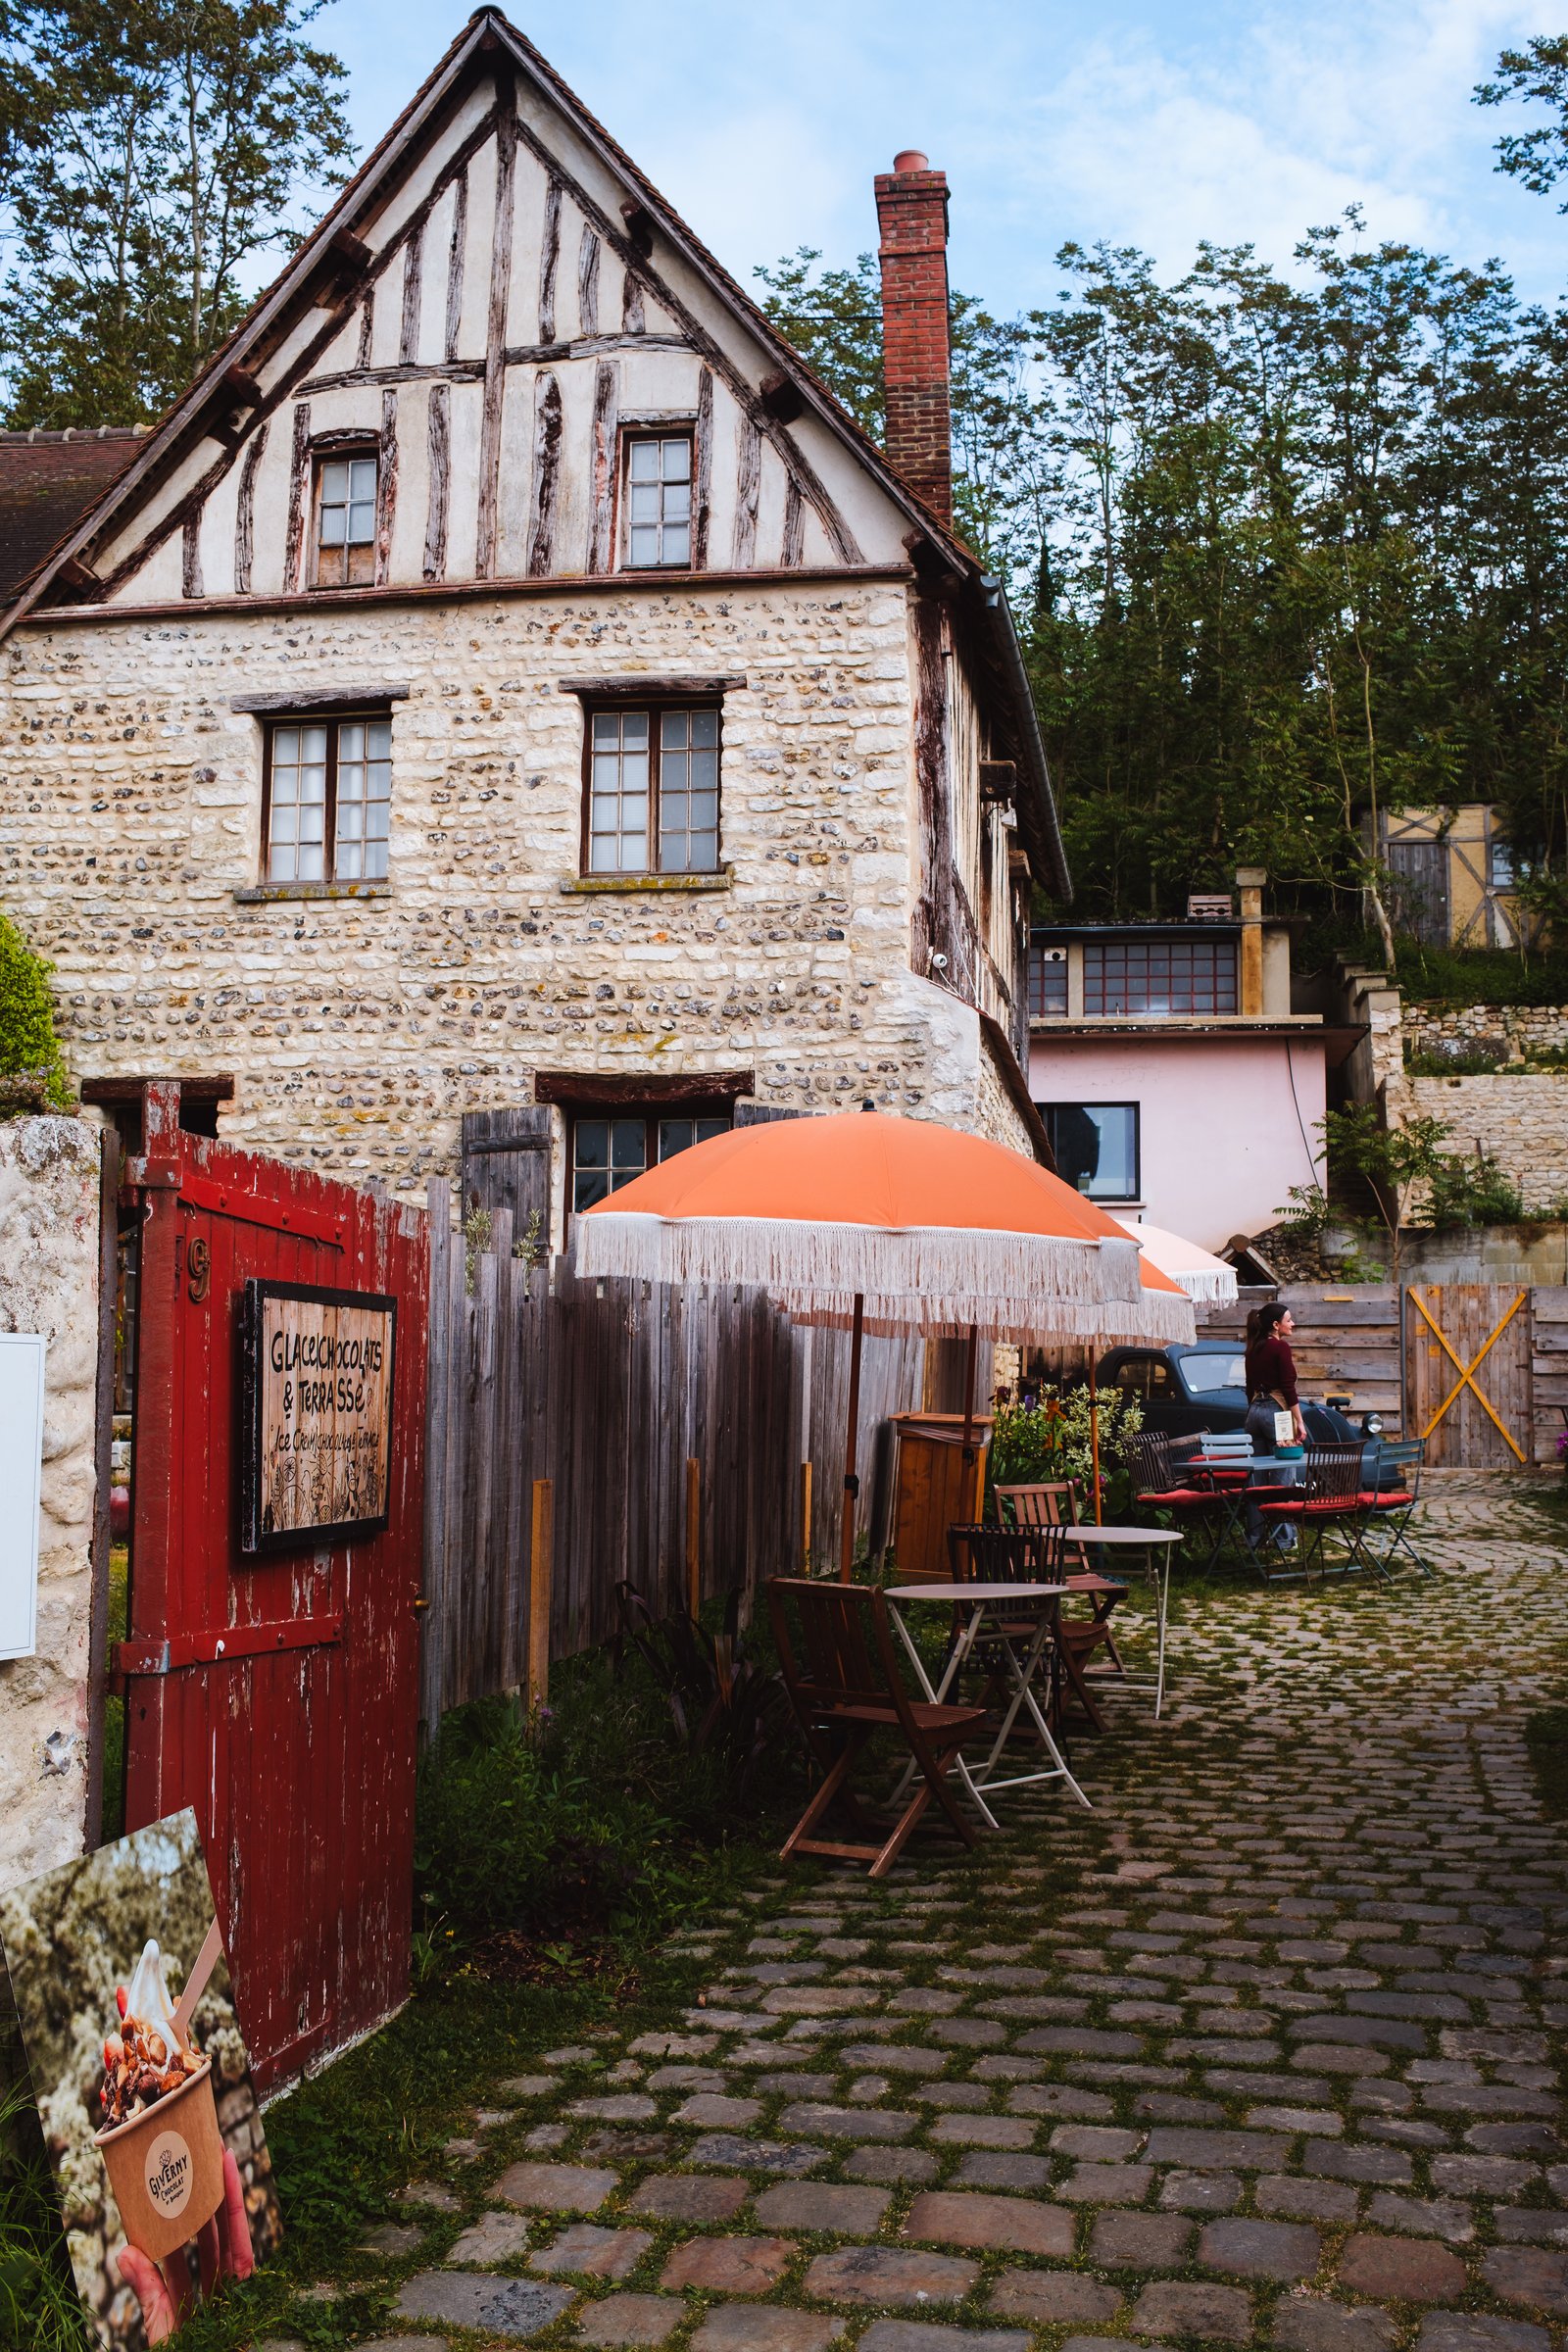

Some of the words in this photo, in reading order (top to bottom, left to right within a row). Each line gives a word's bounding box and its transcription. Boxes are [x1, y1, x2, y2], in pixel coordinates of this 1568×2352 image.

[283, 1380, 294, 1413] &
[274, 1425, 292, 1452] Ice
[149, 2154, 187, 2199] GIVERNY
[161, 2176, 184, 2201] CHOCOLAT
